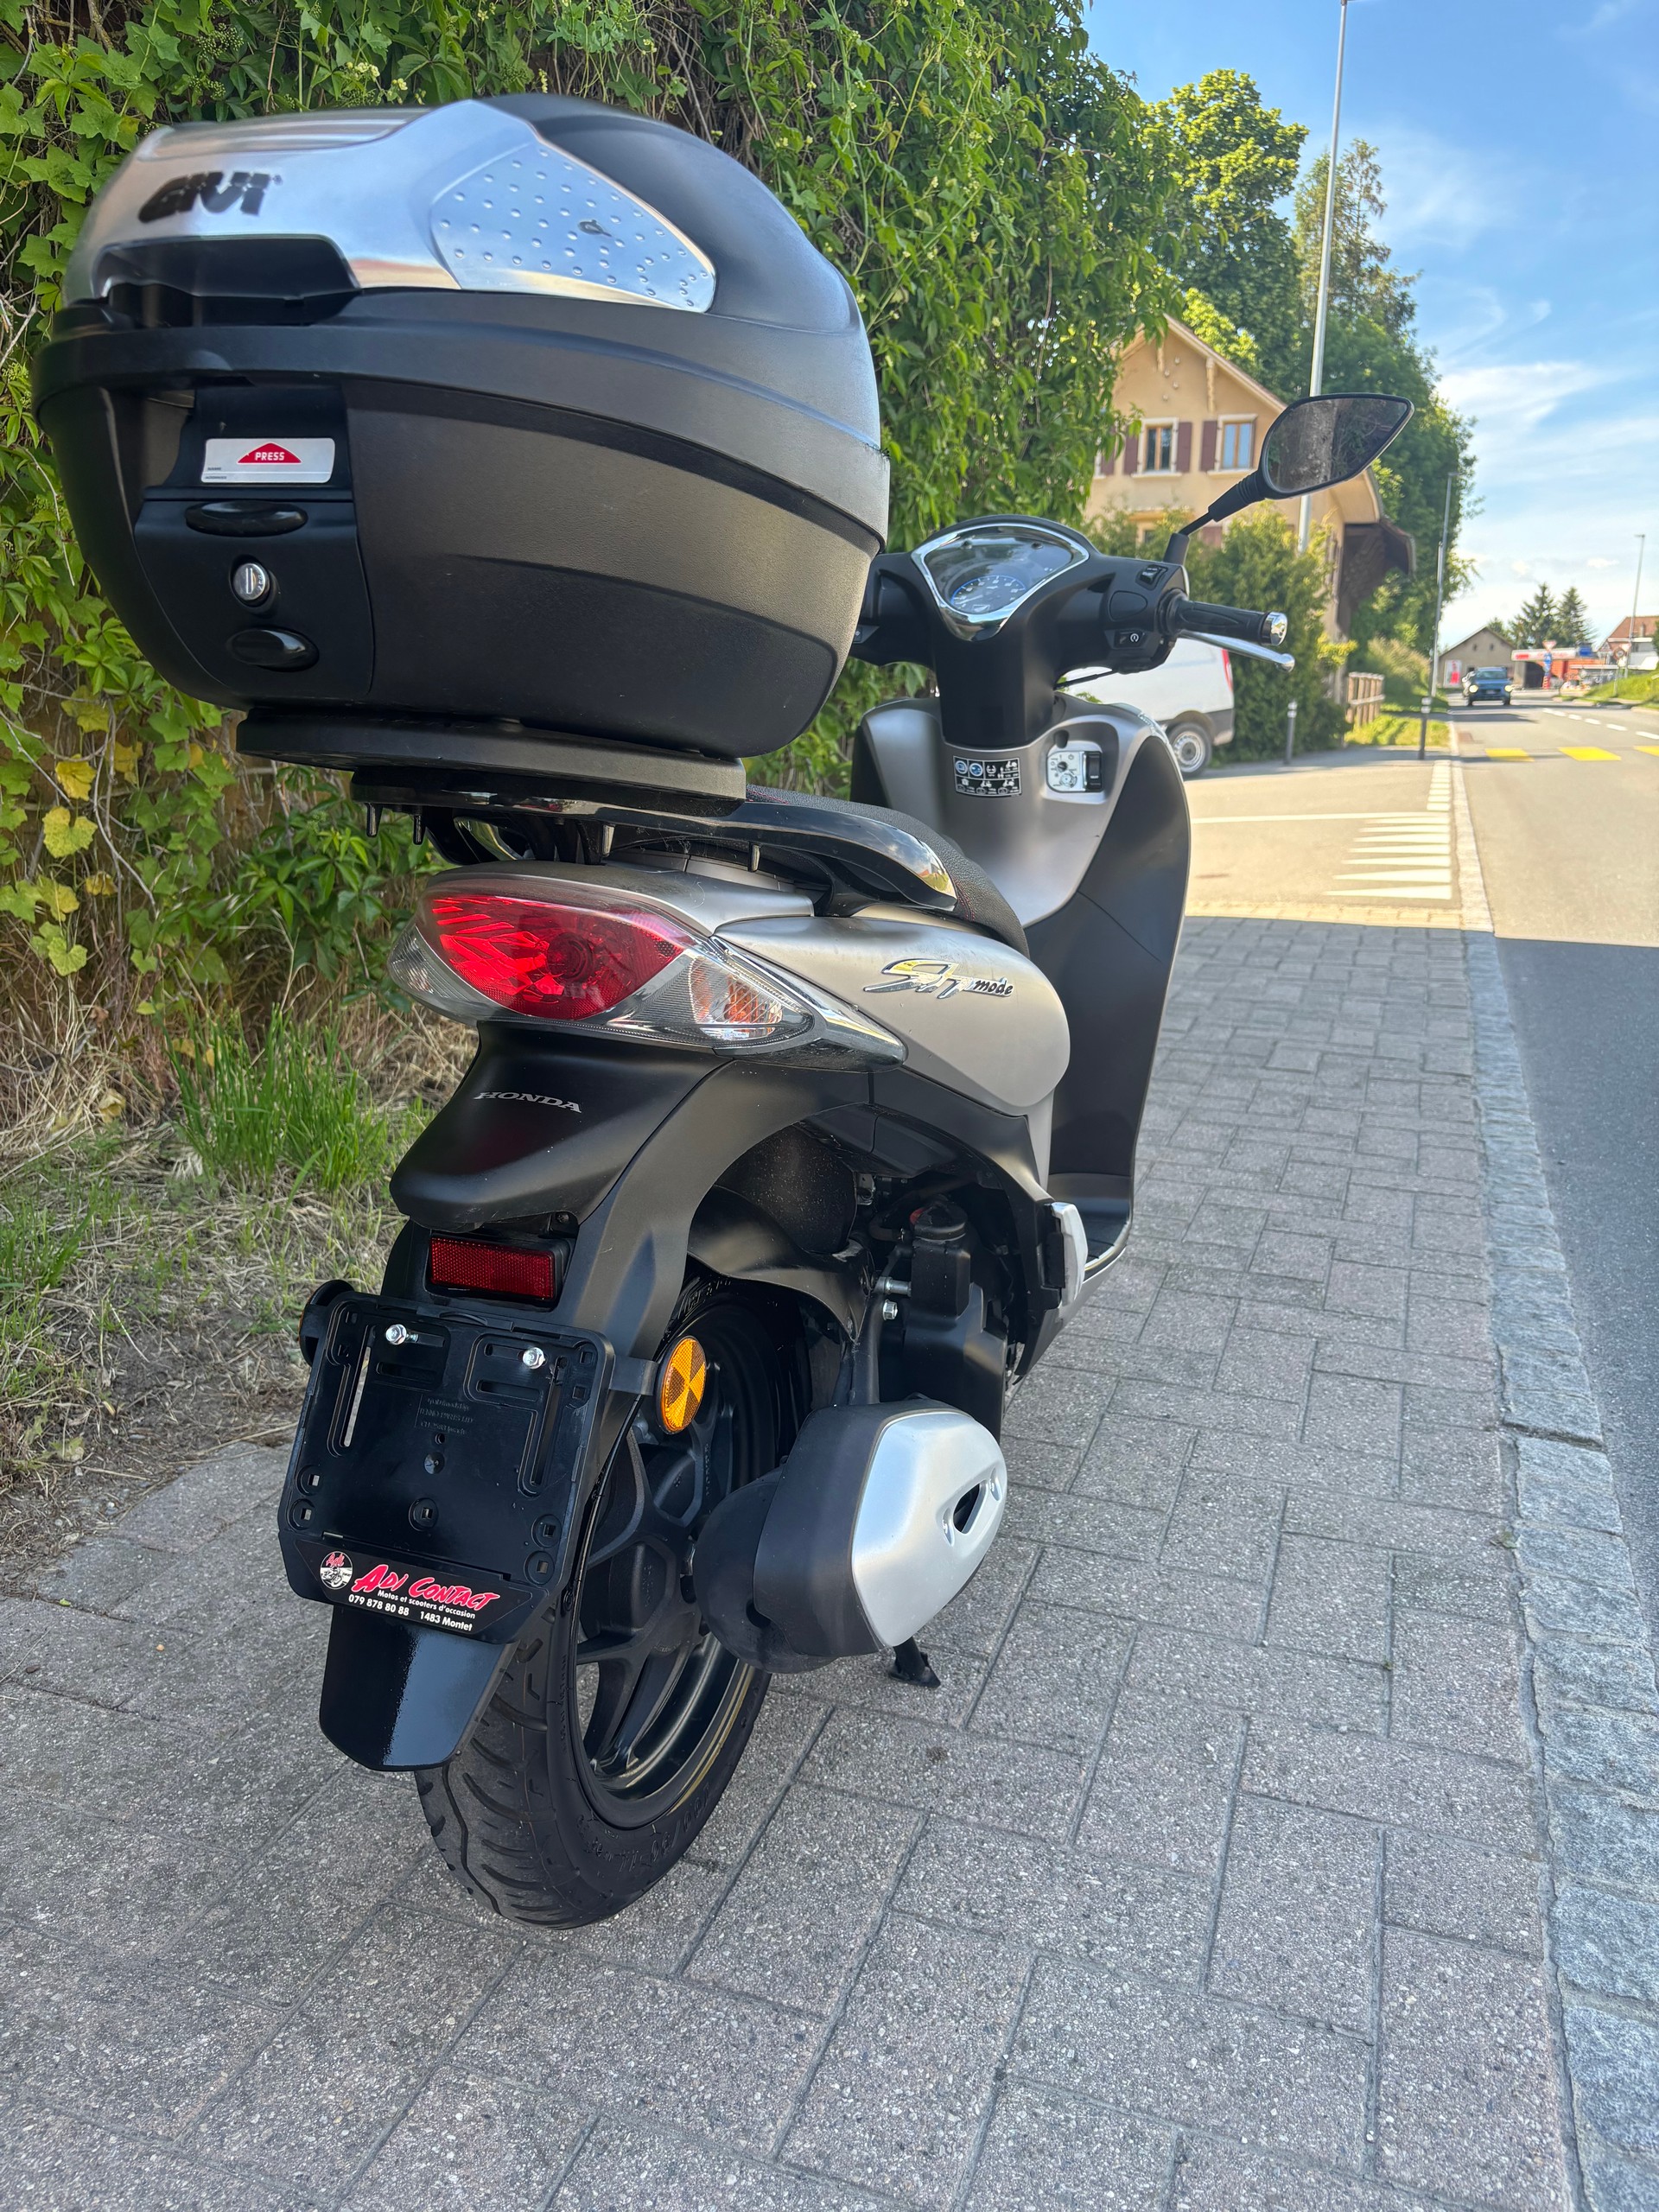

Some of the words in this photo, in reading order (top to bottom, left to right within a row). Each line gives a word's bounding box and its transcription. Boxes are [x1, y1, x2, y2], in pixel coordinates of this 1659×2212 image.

[138, 172, 271, 223] GIVI
[254, 452, 285, 461] PRESS
[973, 977, 1014, 995] mode
[473, 1091, 582, 1113] HONDA
[348, 1593, 365, 1605] 079
[366, 1599, 384, 1610] 878
[385, 1603, 397, 1613] 80
[397, 1606, 410, 1616] 88
[420, 1611, 441, 1624] 1483
[442, 1616, 473, 1631] Montet
[378, 1590, 398, 1601] Motos
[409, 1598, 437, 1610] scooters
[438, 1605, 476, 1619] d'occasion
